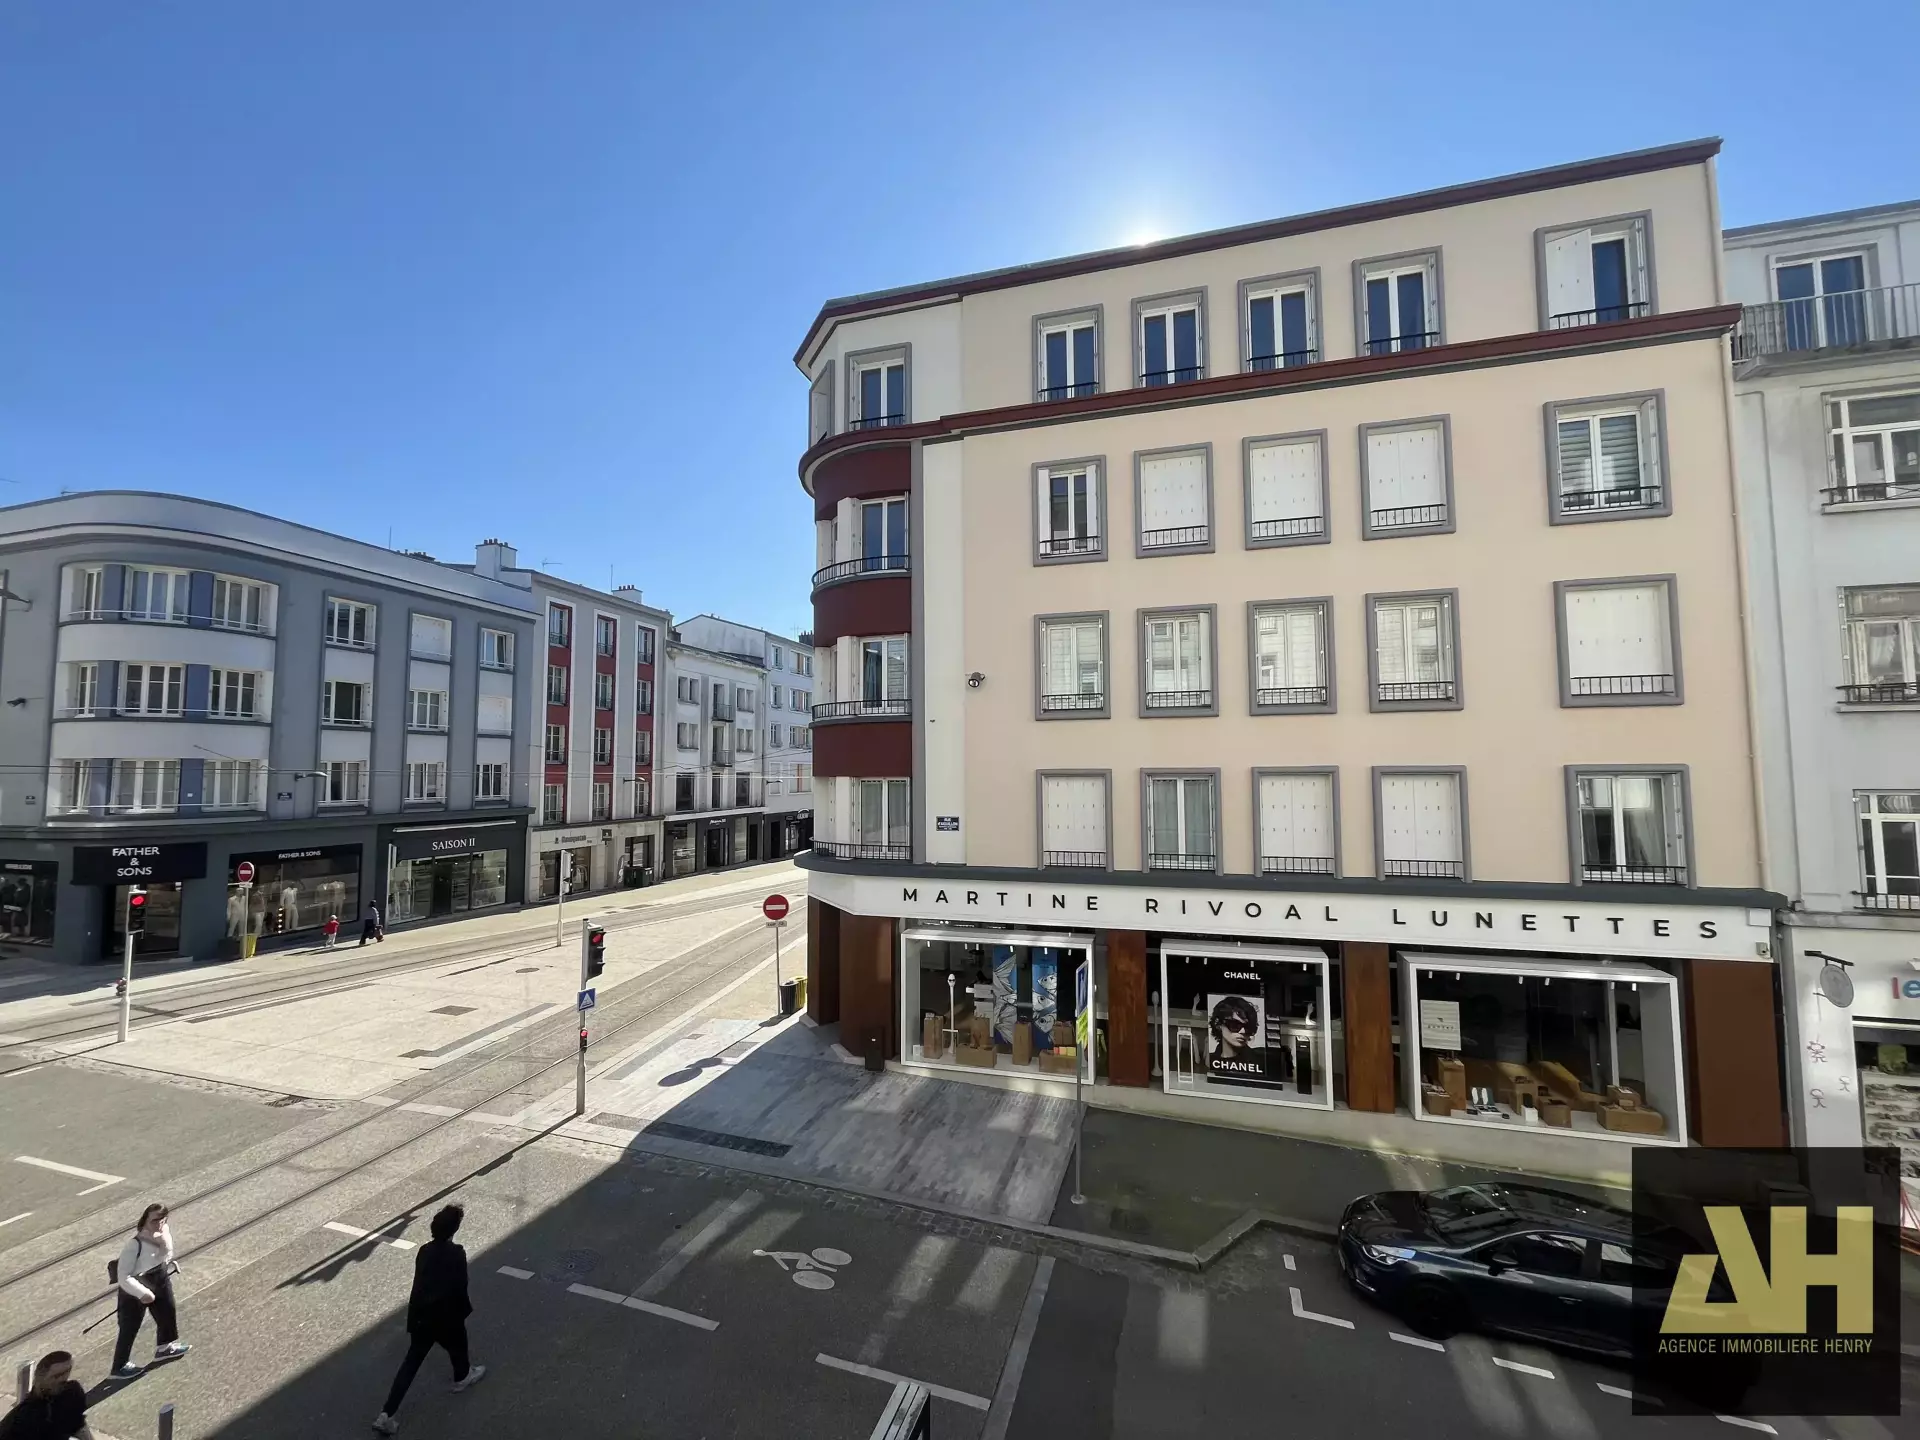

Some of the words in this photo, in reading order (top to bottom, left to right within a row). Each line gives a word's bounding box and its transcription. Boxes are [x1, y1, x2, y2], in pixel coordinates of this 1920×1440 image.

[432, 839, 467, 850] SAISON
[469, 838, 475, 846] II
[112, 847, 160, 856] FATHER
[130, 857, 139, 865] &
[117, 867, 152, 876] SONS
[903, 888, 1098, 911] MARTINE
[1145, 898, 1338, 922] RIVOAL
[1393, 908, 1717, 939] LUNETTES
[1223, 971, 1261, 981] CHANEL
[1212, 1059, 1263, 1073] CHANEL
